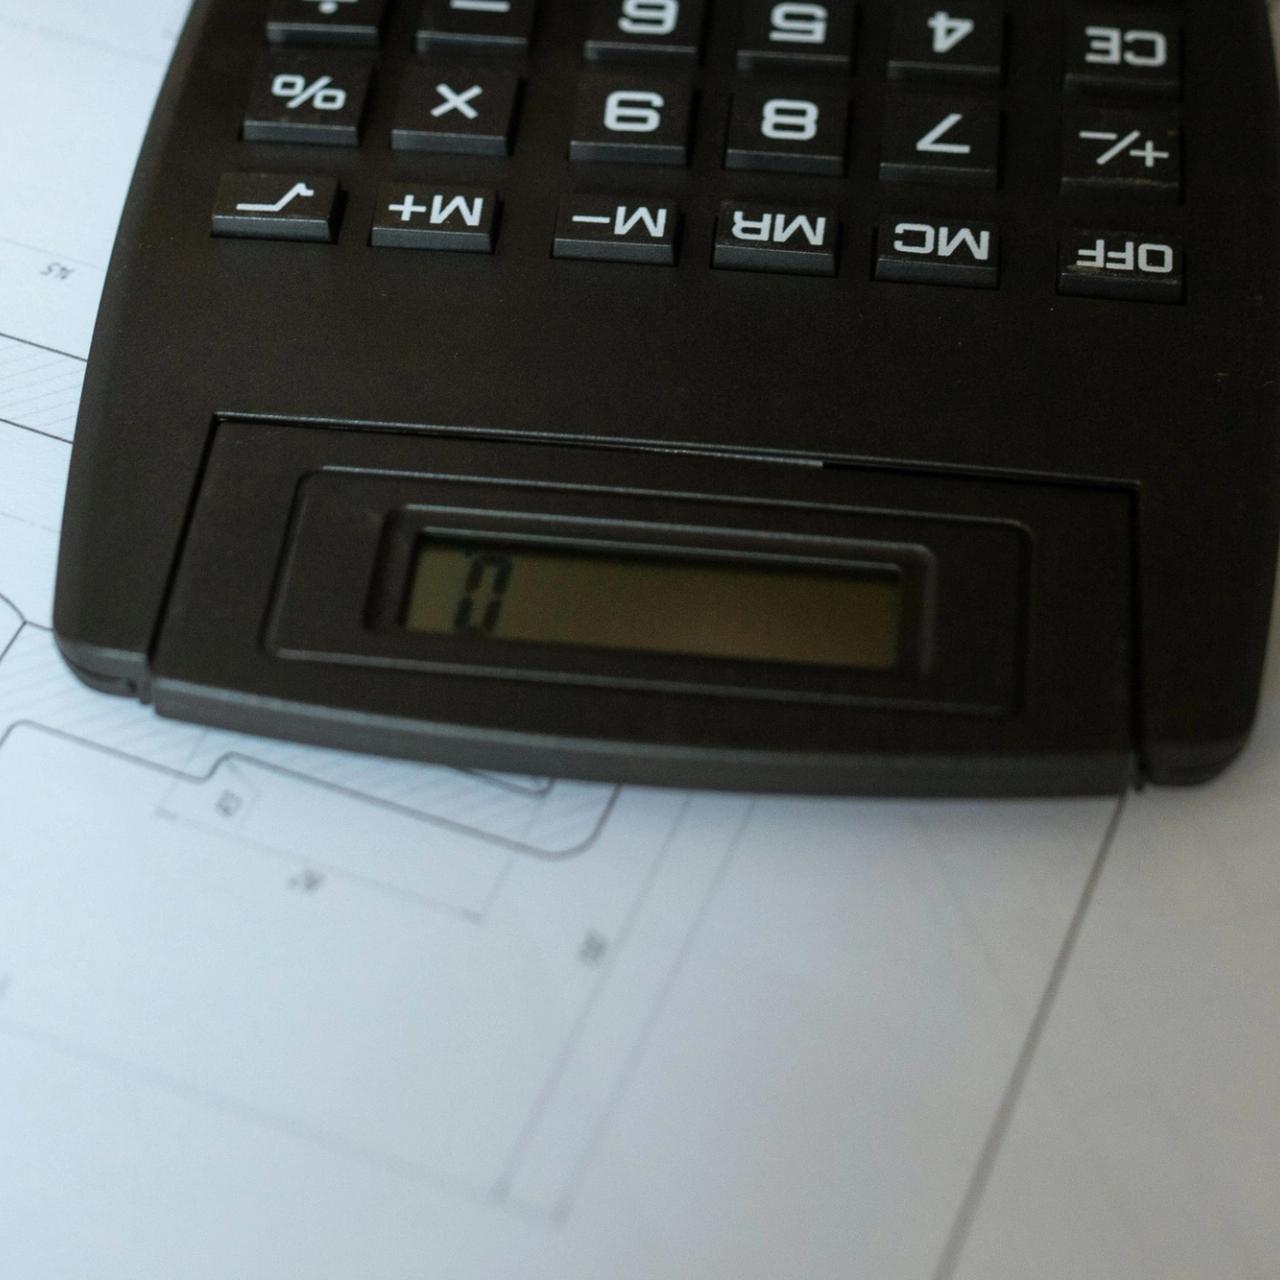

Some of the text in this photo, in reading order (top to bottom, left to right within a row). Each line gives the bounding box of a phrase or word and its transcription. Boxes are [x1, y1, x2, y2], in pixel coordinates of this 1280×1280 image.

[770, 3, 826, 42] 5
[928, 12, 973, 52] 4
[1086, 27, 1166, 66] CE
[272, 75, 345, 109] %
[604, 91, 663, 131] 9
[762, 100, 818, 140] 8
[917, 114, 970, 153] 7
[388, 195, 483, 226] M+
[572, 206, 666, 237] M-
[732, 211, 826, 245] MR
[894, 223, 989, 260] MC
[1077, 239, 1172, 272] OFF
